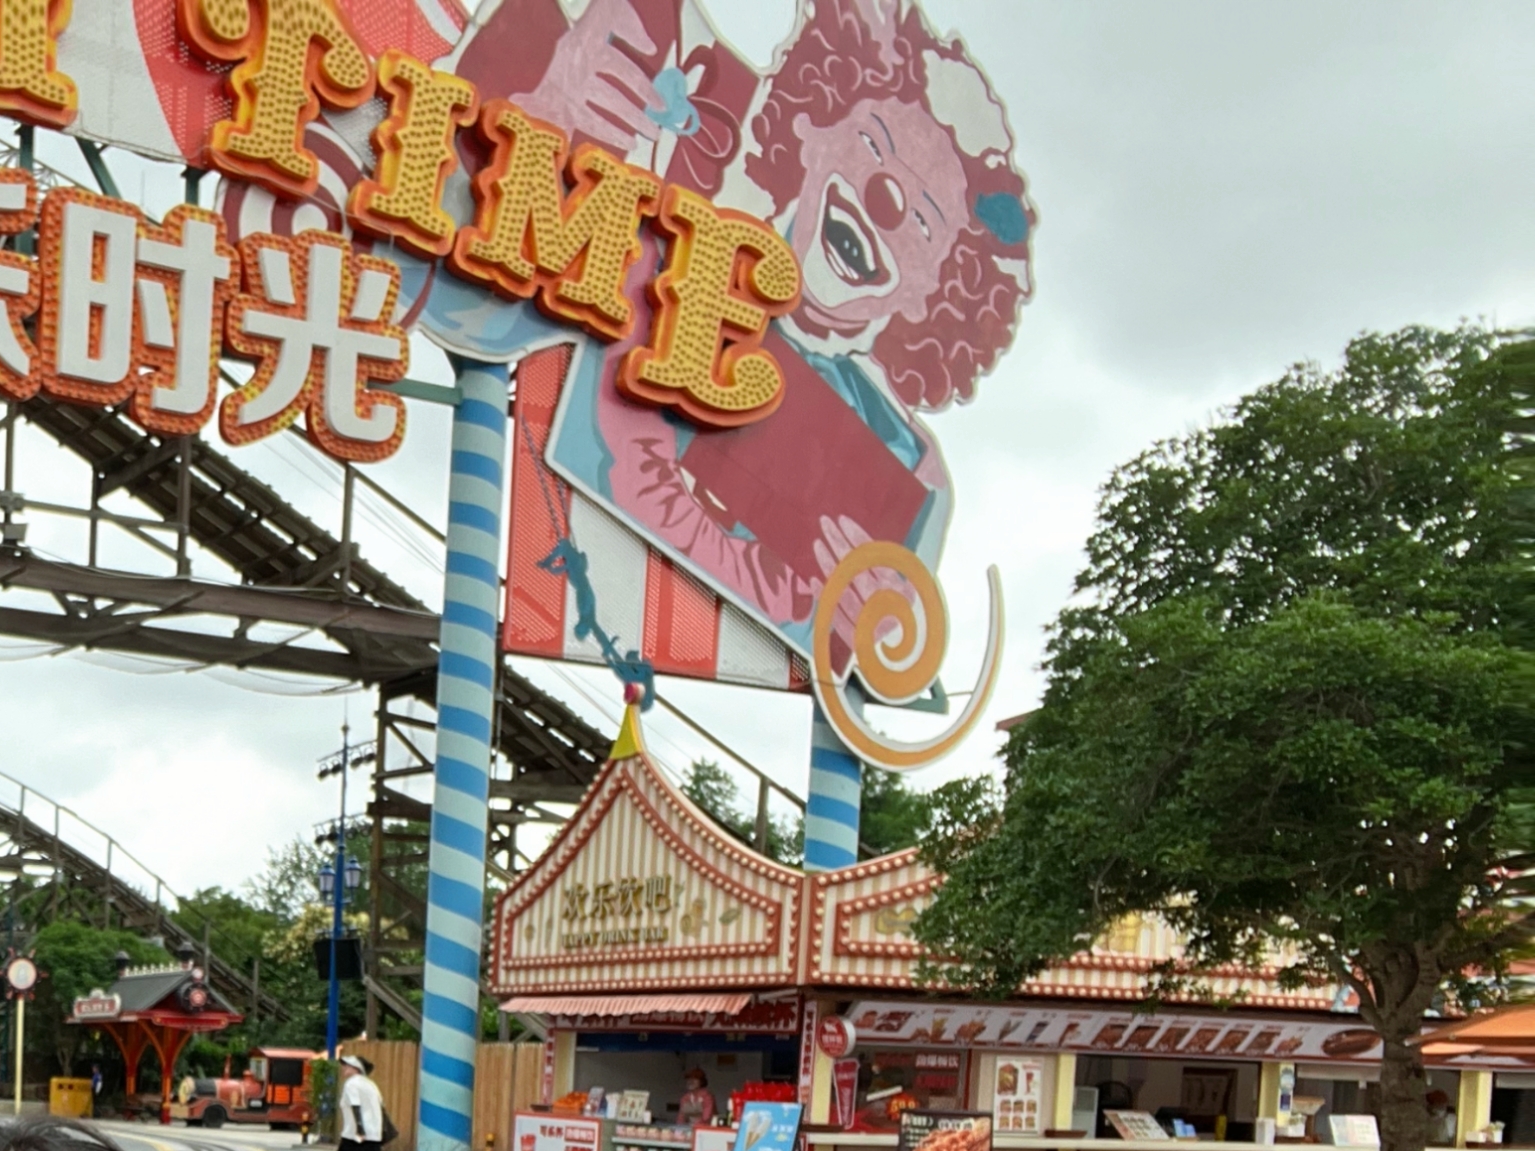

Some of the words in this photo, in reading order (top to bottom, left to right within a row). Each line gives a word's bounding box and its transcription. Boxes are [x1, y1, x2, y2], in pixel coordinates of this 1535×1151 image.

[198, 0, 801, 414] TIME
[562, 875, 671, 920] 欢乐饮吧
